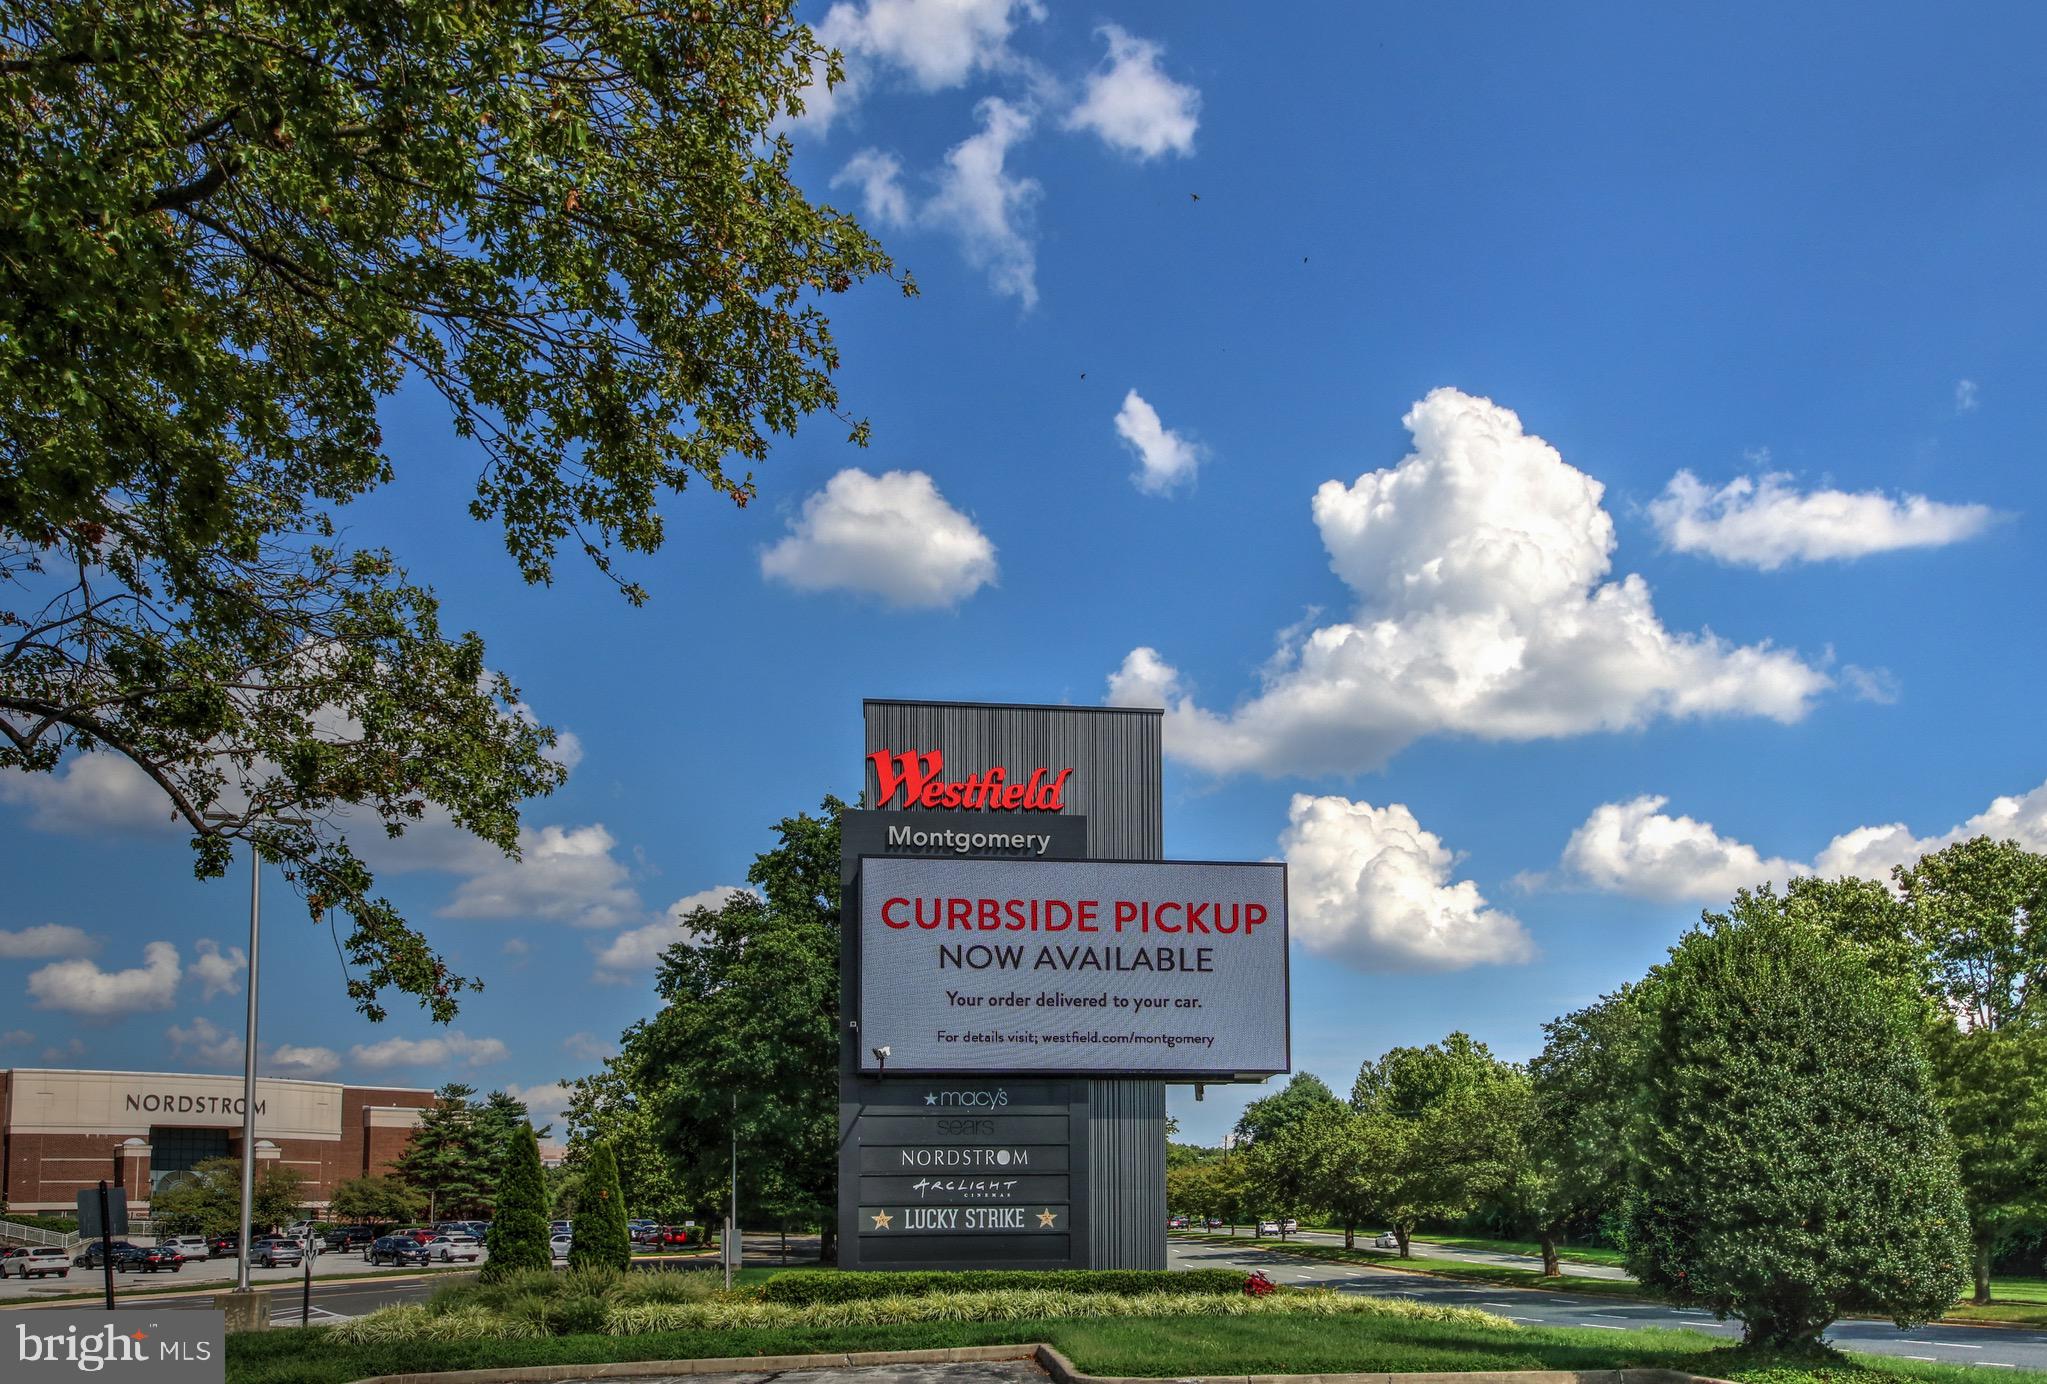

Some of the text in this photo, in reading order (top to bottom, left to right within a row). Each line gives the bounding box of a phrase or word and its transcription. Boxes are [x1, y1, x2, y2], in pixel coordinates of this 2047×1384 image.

[867, 748, 1073, 811] Westfield
[888, 825, 1050, 854] Montgomery
[881, 897, 1268, 934] CURBSIDE PICKUP
[939, 944, 1214, 972] NOW AVAILABLE
[946, 990, 1203, 1014] Your order delivered to your car.
[937, 1030, 960, 1043] For
[962, 1030, 1005, 1043] details
[1042, 1031, 1215, 1049] westfield.com/montgomery
[936, 1119, 995, 1136] sears
[901, 1149, 1029, 1166] NORDSTROM
[904, 1208, 1025, 1229] LUCKY STRIKE
